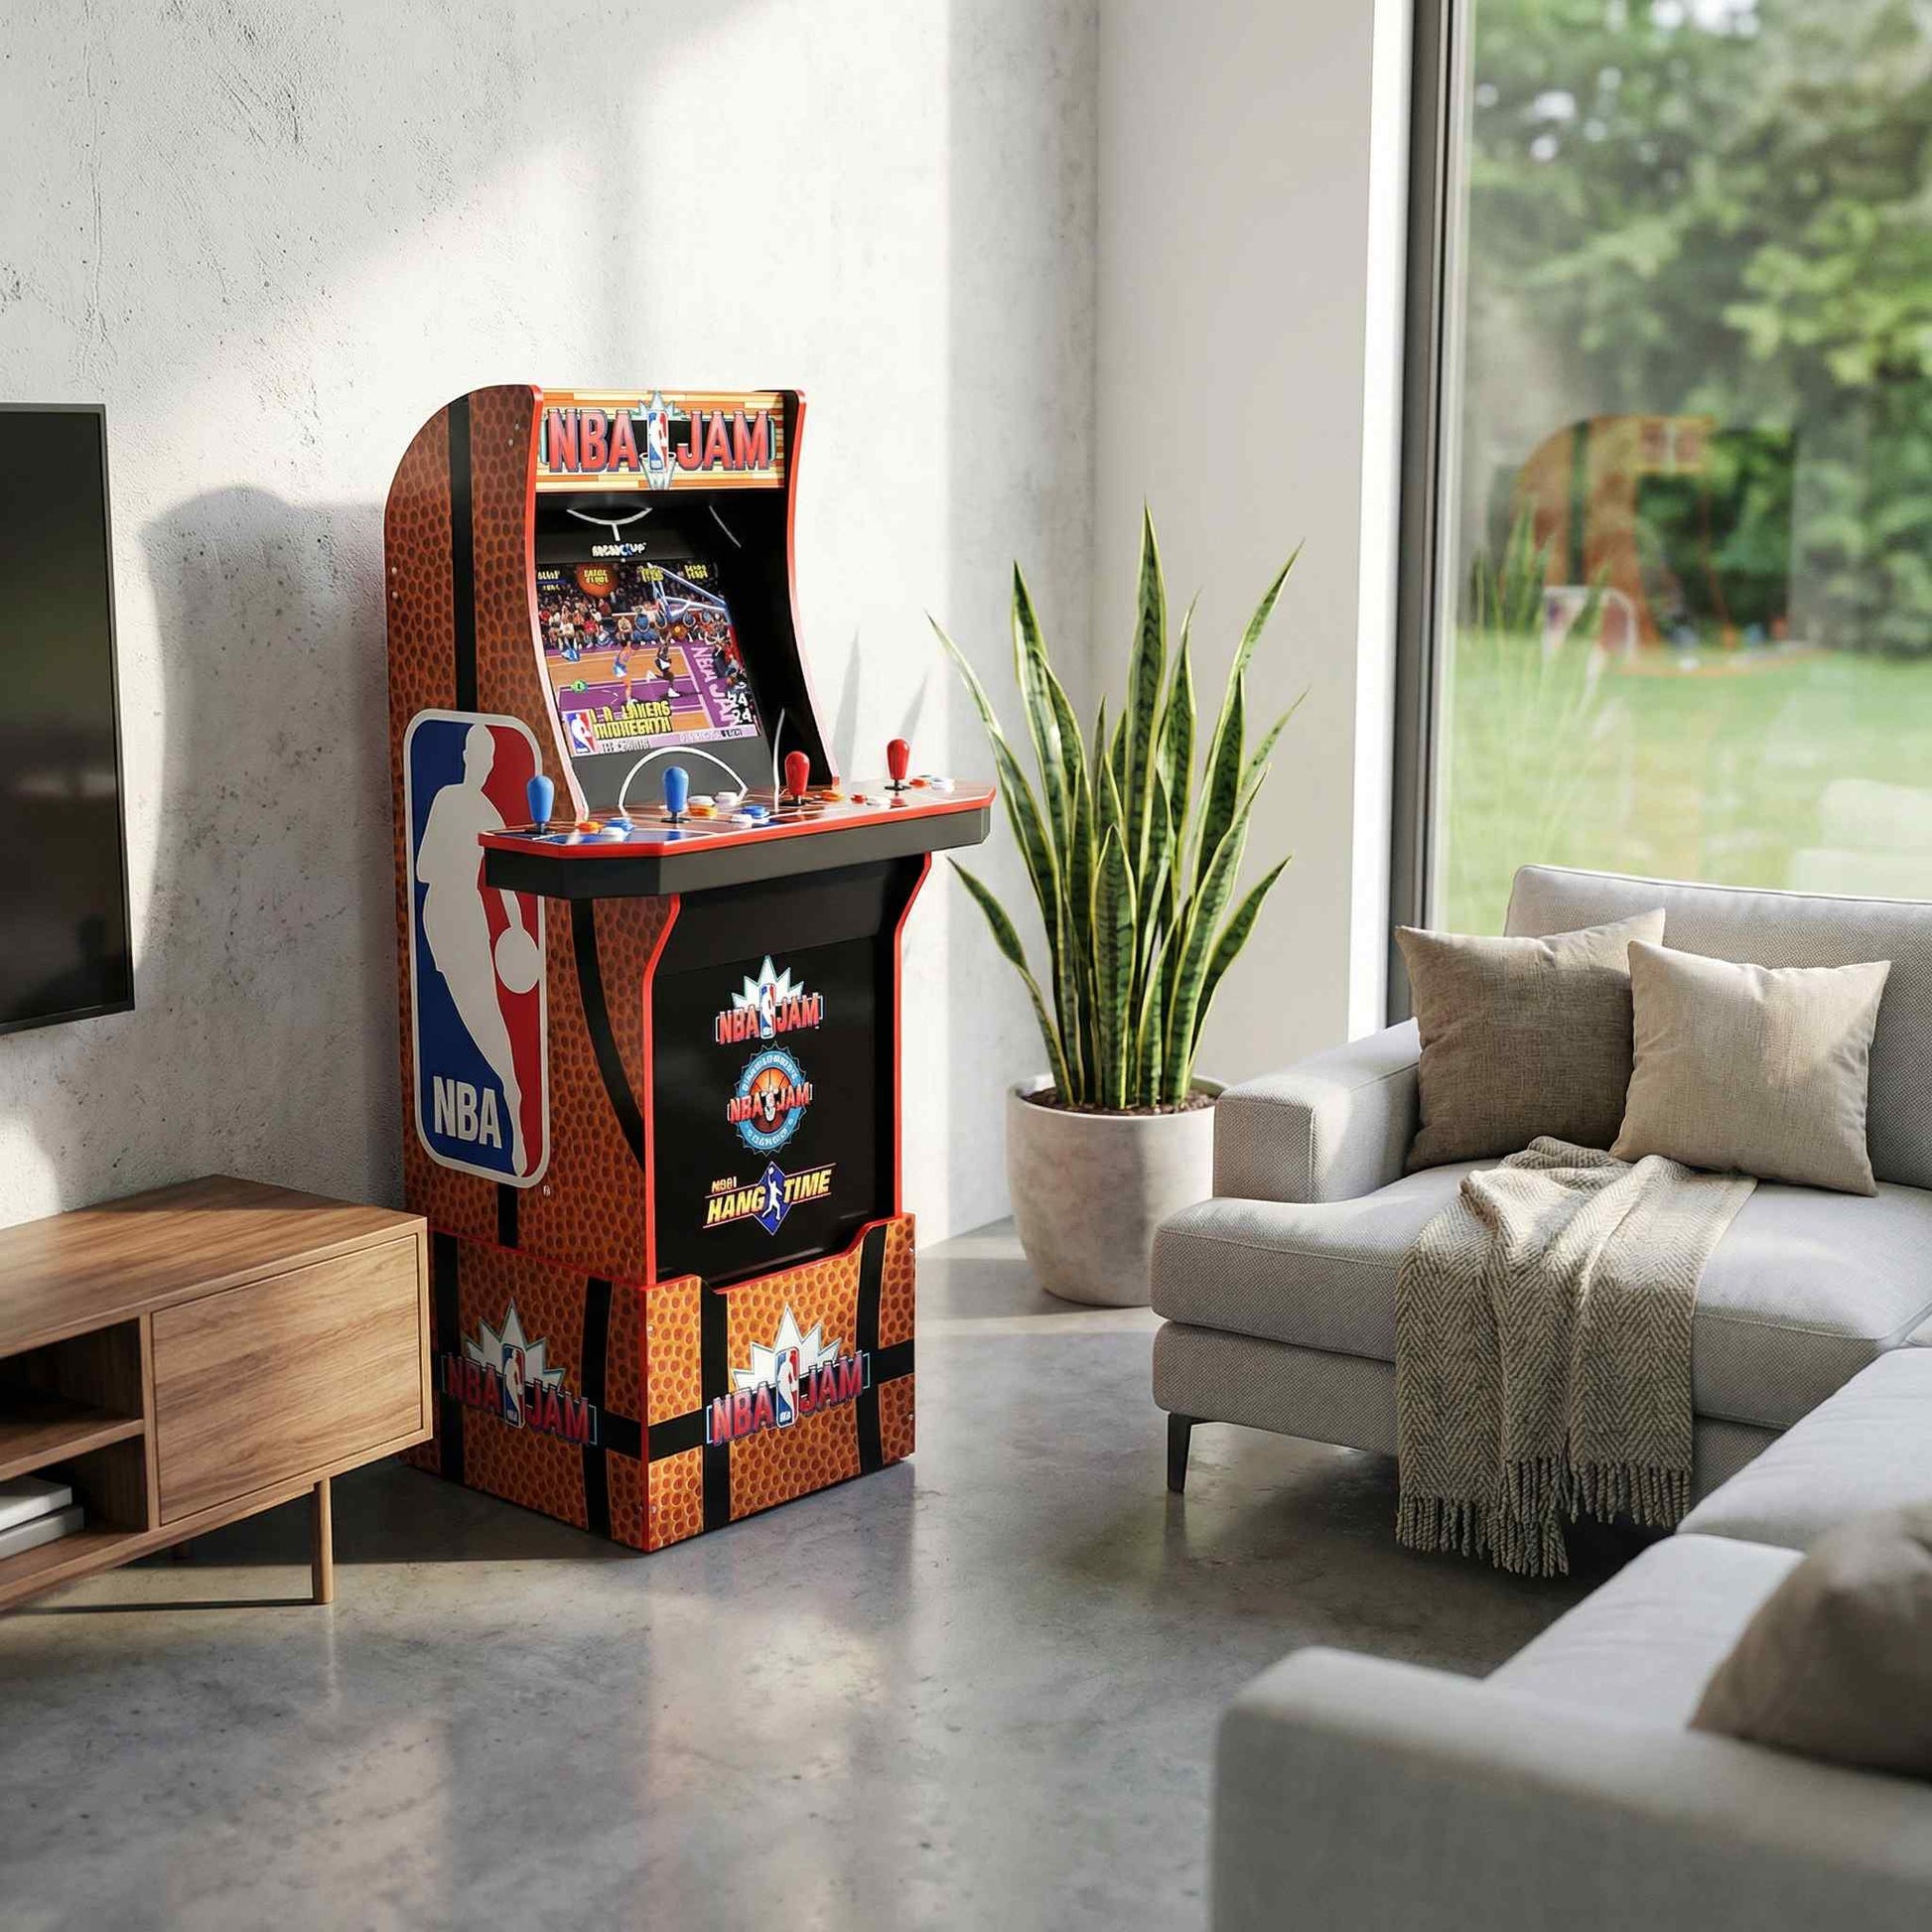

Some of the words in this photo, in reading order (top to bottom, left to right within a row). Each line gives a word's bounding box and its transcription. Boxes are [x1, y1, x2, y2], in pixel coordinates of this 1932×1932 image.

[547, 409, 640, 473] NBA
[677, 410, 769, 472] JAM
[719, 1003, 759, 1044] NBA
[776, 992, 820, 1033] JAM
[433, 1075, 502, 1150] NBA
[730, 1091, 763, 1124] NBA
[776, 1081, 811, 1111] JAM
[707, 1185, 766, 1224] HANG
[783, 1169, 832, 1203] TIME
[447, 1351, 502, 1414] NBA
[525, 1377, 590, 1446] JAM
[712, 1380, 774, 1447] NBA
[798, 1349, 864, 1415] JAM
